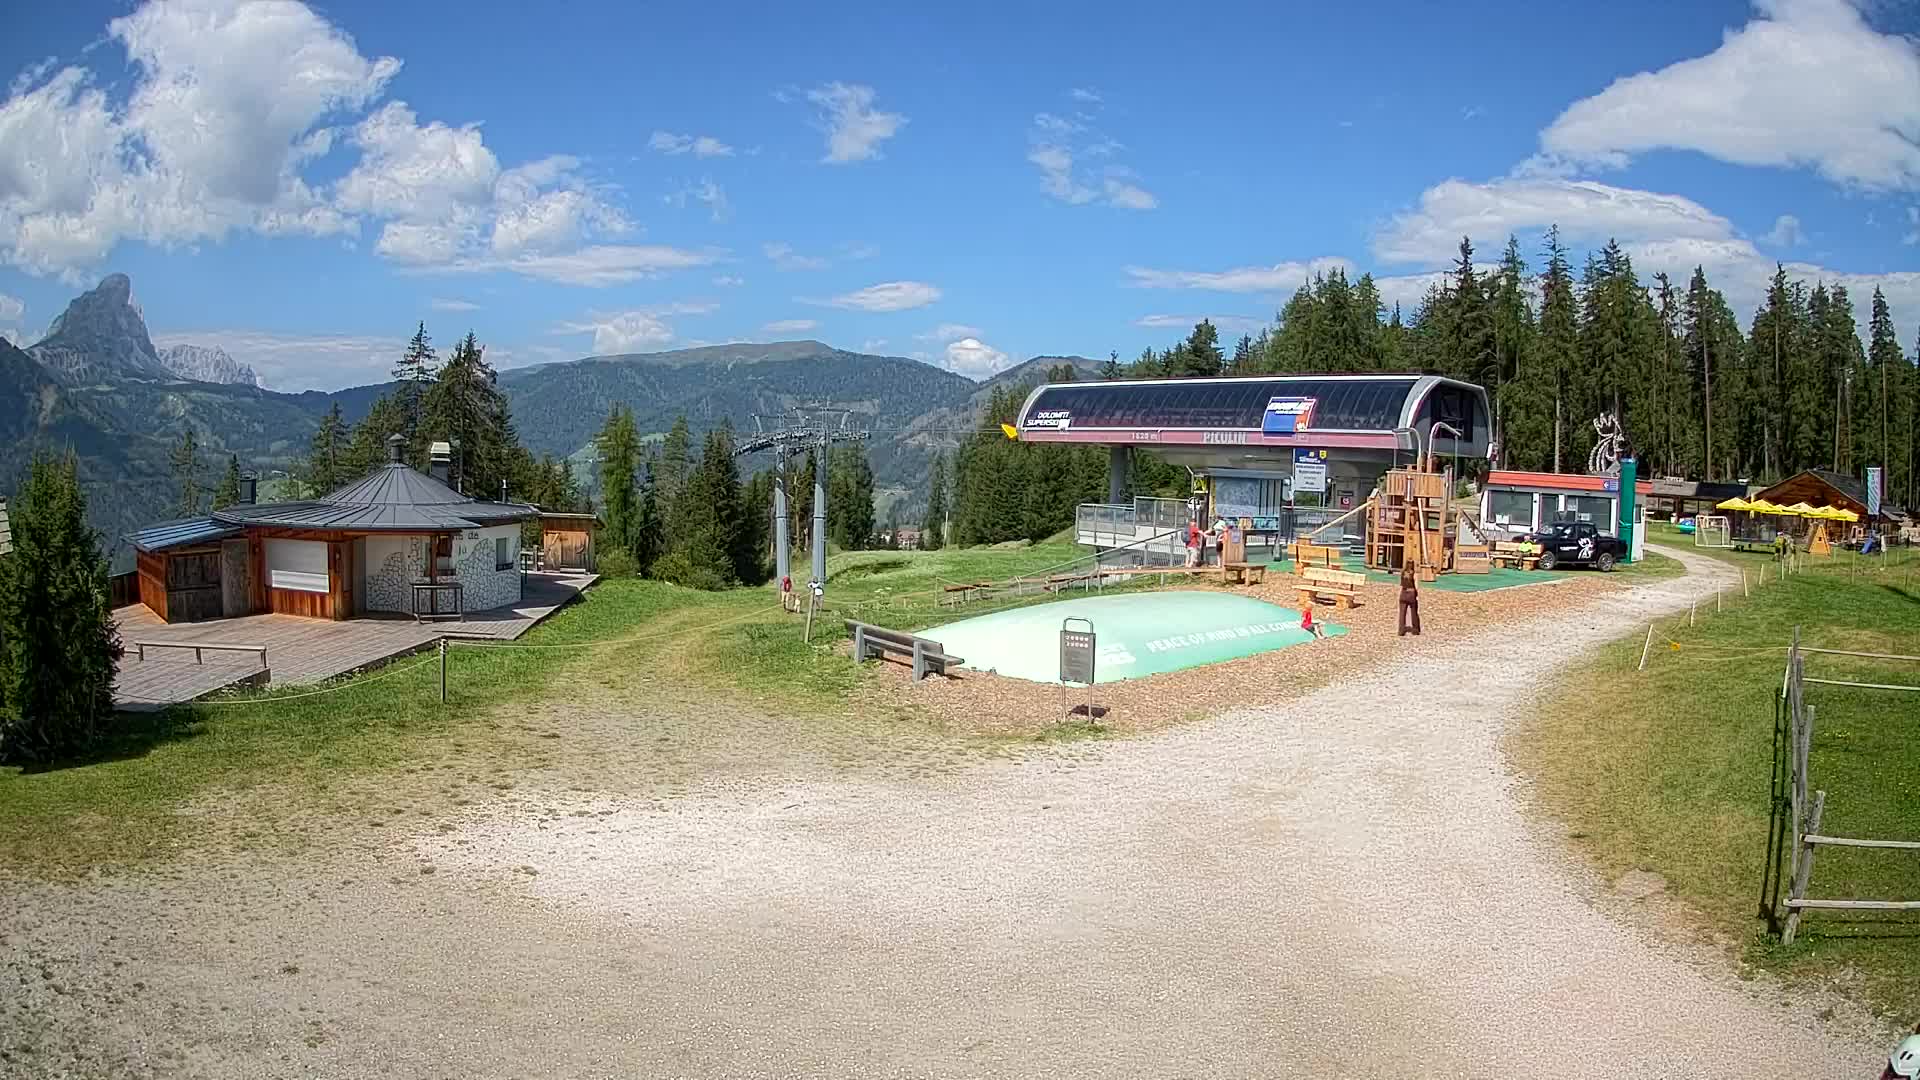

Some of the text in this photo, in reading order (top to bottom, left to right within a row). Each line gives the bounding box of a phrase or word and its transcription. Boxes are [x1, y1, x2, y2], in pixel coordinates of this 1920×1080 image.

[1203, 431, 1247, 444] PICULIN
[1146, 636, 1190, 653] PEACE
[1187, 633, 1206, 646] OF
[1205, 629, 1237, 642] MIND
[1235, 627, 1250, 638] IN
[1248, 623, 1271, 635] ALL
